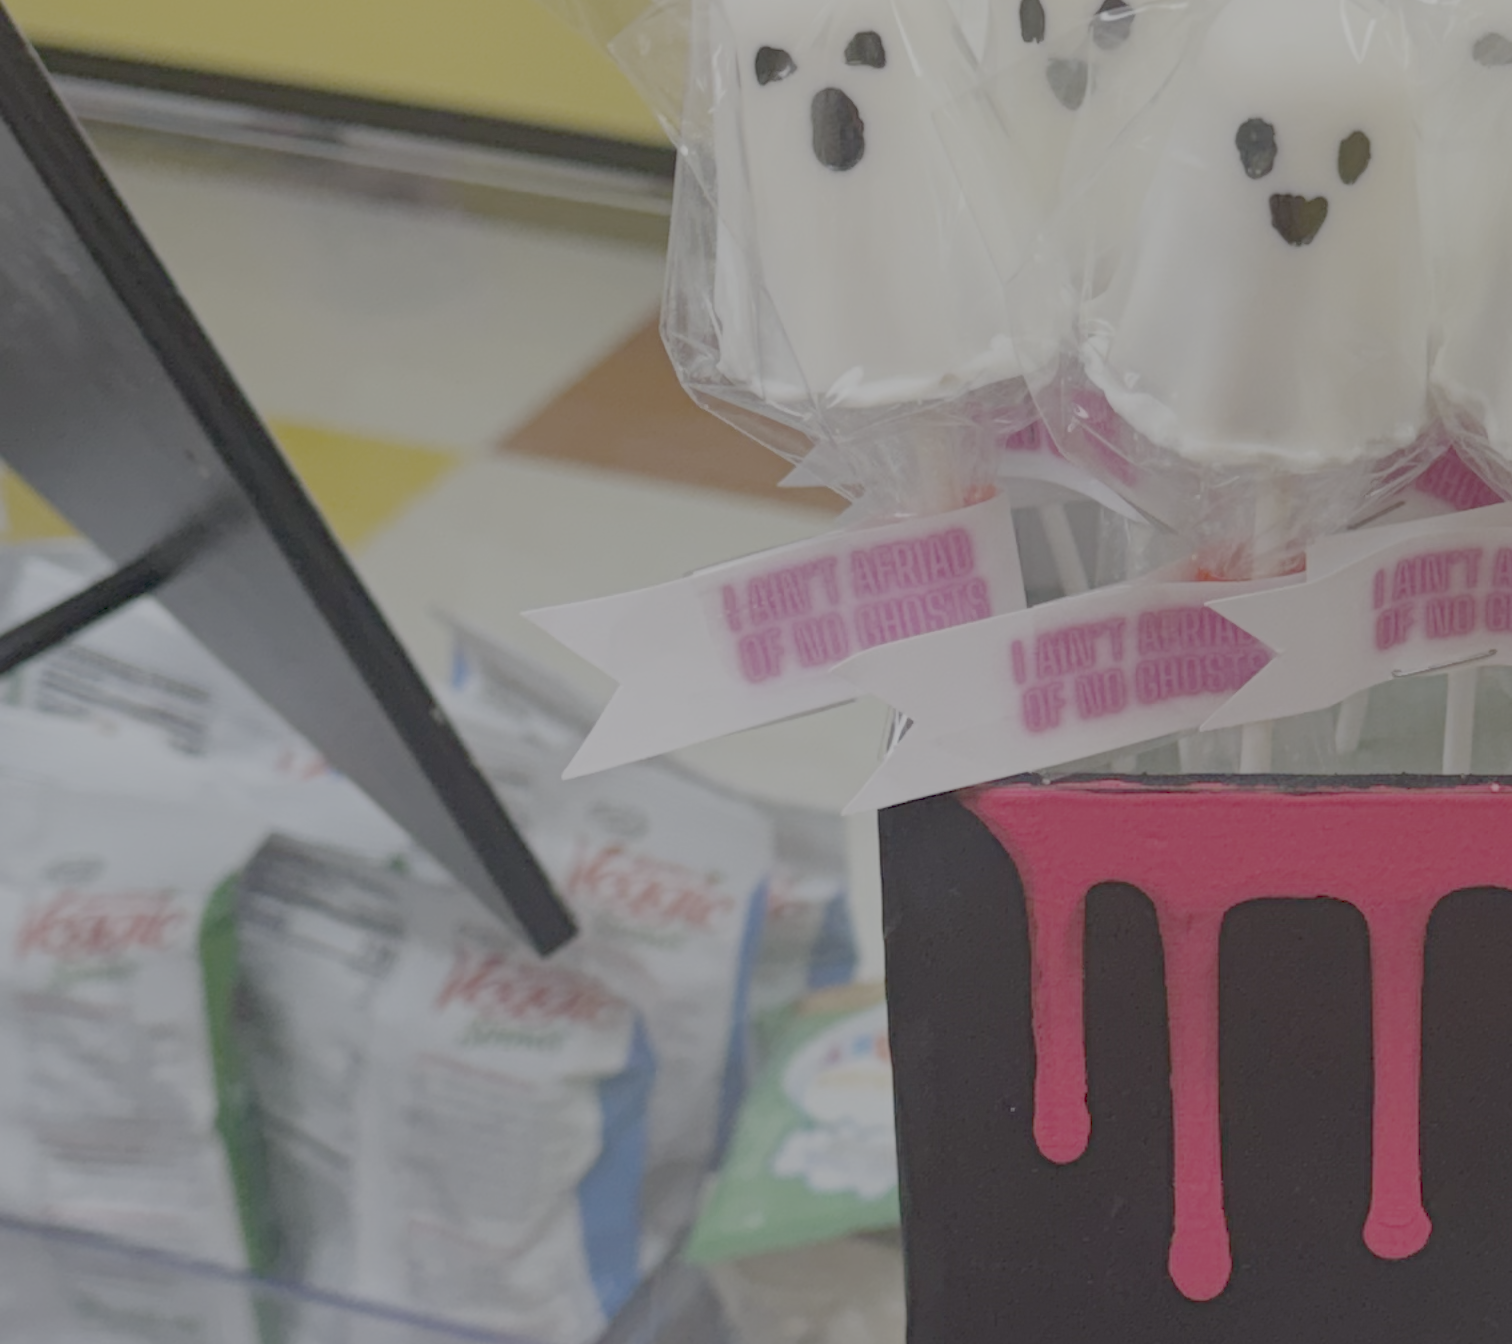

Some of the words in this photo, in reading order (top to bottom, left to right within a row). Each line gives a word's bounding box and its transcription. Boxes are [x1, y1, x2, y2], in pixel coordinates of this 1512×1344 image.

[722, 583, 742, 632] I
[748, 555, 839, 626] AIN'T
[850, 527, 974, 600] AFRIAD
[1370, 567, 1388, 610] I
[1391, 547, 1483, 602] AIN'T
[738, 626, 784, 684] OF
[792, 610, 850, 668] NO
[853, 575, 992, 651] GHOSTS
[1010, 639, 1026, 685] I
[1035, 616, 1127, 680] AIN'T
[1374, 603, 1415, 650] OF
[1424, 593, 1477, 640] NO
[1023, 681, 1065, 732] OF
[1075, 667, 1126, 720] NO
